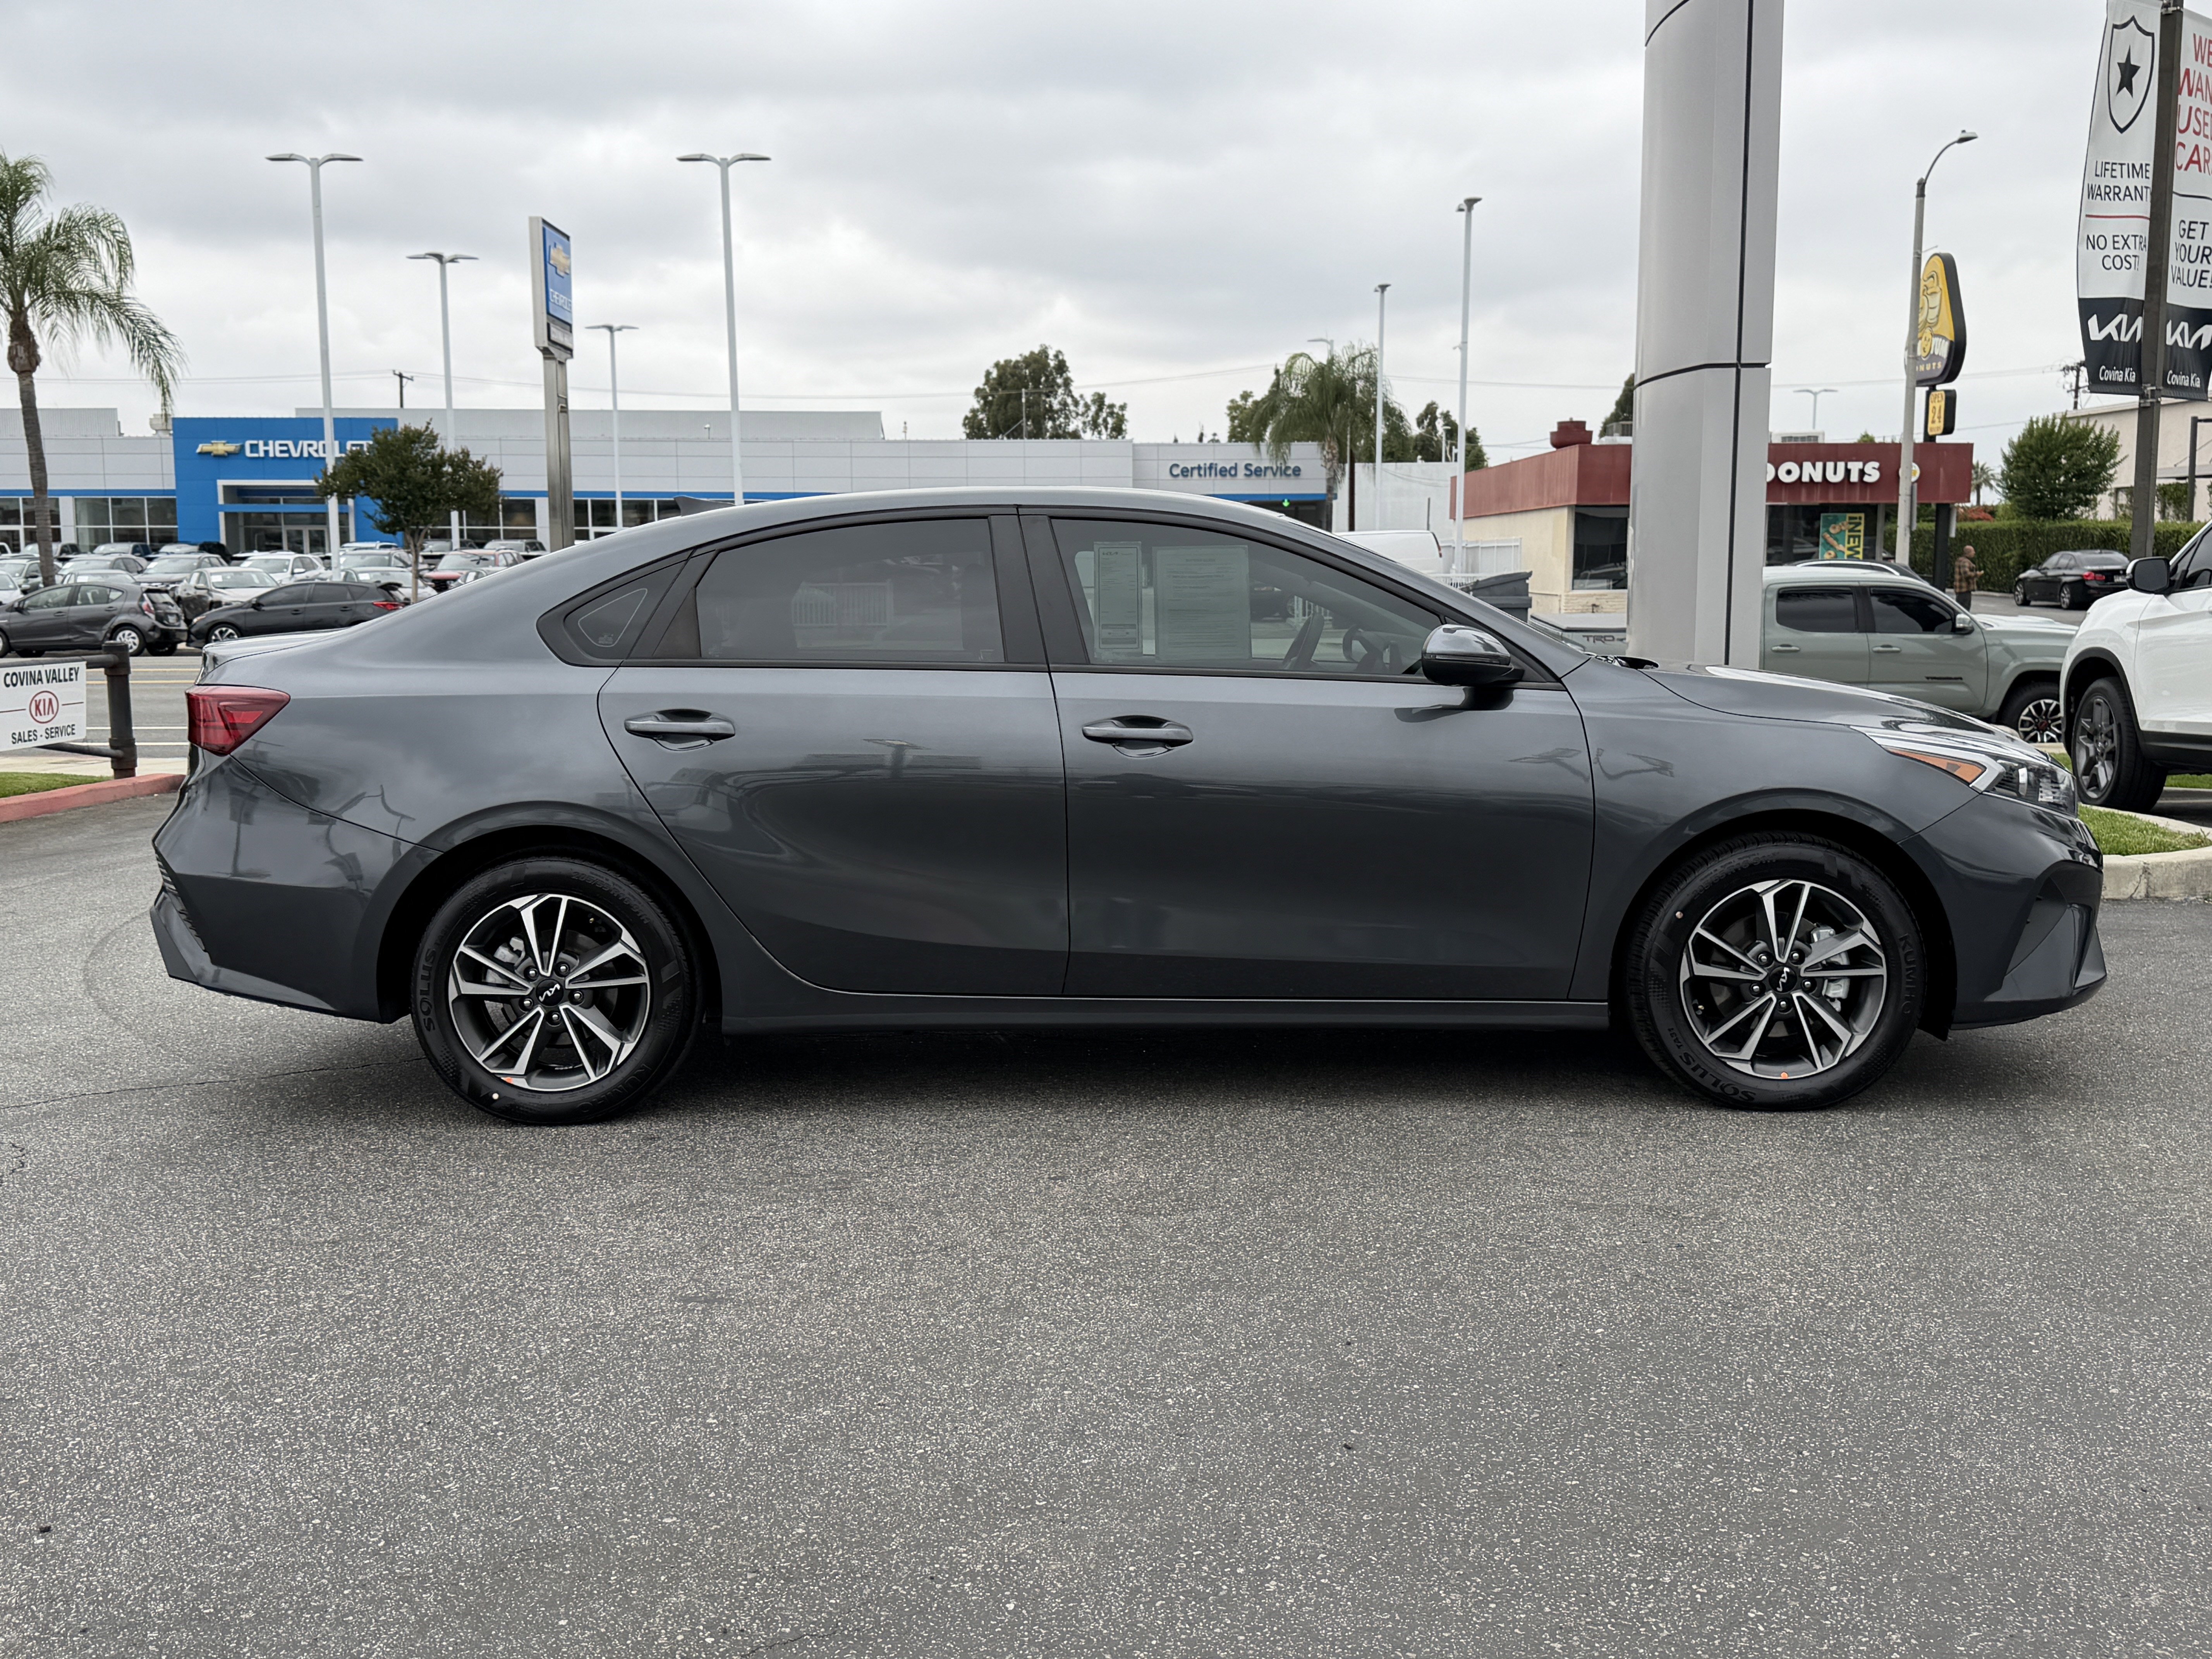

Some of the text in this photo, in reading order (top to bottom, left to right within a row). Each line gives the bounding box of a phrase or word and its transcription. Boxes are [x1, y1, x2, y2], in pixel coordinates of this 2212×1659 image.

[2178, 68, 2212, 105] WAN
[2177, 104, 2212, 140] USE
[2176, 141, 2212, 175] CAR
[2095, 160, 2150, 179] LIFETIME
[2087, 183, 2151, 202] WARRANT
[2179, 219, 2209, 240] GET
[2086, 234, 2147, 252] NO EXTRA
[2102, 254, 2140, 271] COST!
[2175, 242, 2212, 264] YOUR
[1916, 361, 1942, 372] NUTS
[2099, 365, 2136, 383] Covina Kia
[2167, 370, 2200, 388] Covina Kia
[1931, 405, 1941, 424] 24
[1169, 462, 1301, 477] Certified Service
[3, 666, 80, 687] COVINA VALLEY
[34, 698, 54, 716] KIA
[12, 730, 38, 744] SALES
[45, 724, 76, 740] SERVICE
[1679, 1052, 1756, 1102] SOLUS
